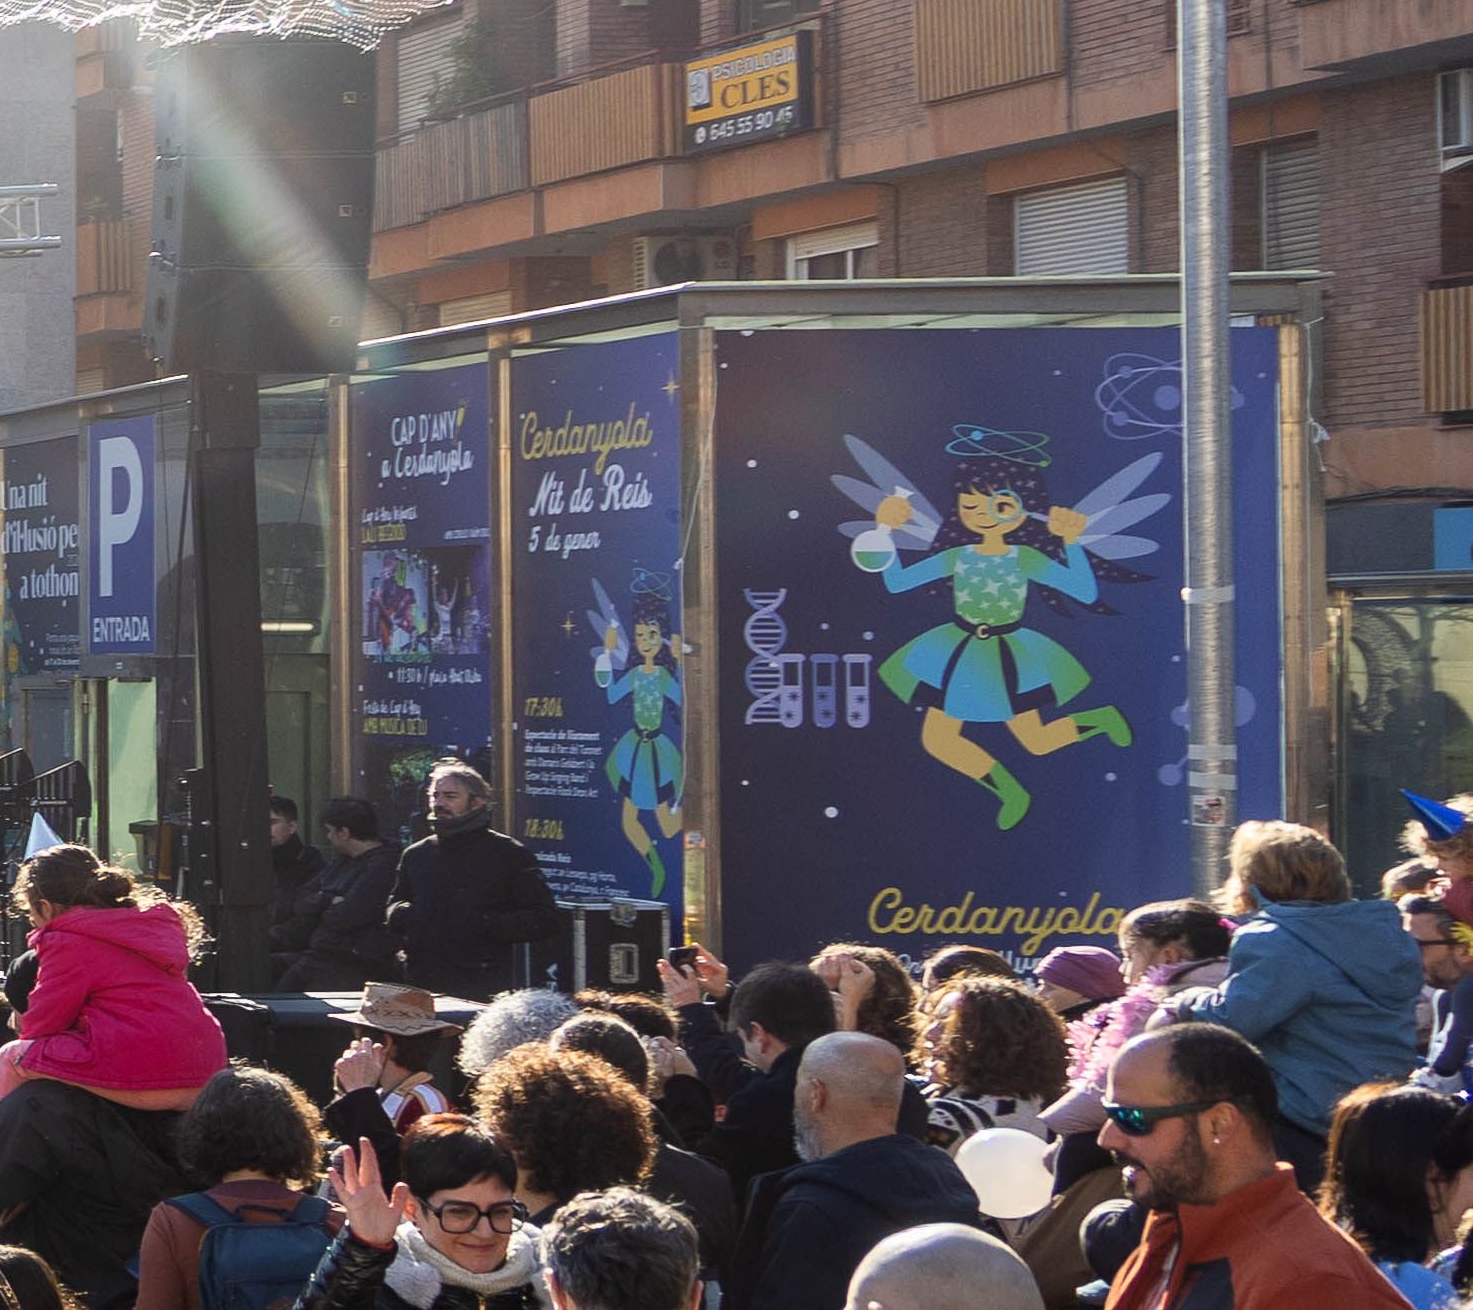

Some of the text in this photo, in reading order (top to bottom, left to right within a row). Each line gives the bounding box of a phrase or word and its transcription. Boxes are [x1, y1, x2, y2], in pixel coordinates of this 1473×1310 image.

[711, 45, 796, 81] PSICOLOGIA
[721, 69, 790, 109] CLES
[709, 122, 734, 140] 645
[736, 118, 753, 135] 55
[755, 111, 773, 131] 90
[392, 410, 457, 446] CAP D'ANY
[522, 402, 653, 475] Cerdanyola
[381, 441, 474, 485] a Cerdanyola
[28, 473, 48, 507] nit
[529, 464, 653, 516] Nit de Reis
[99, 436, 143, 597] P
[58, 523, 80, 558] pe
[528, 523, 601, 559] 5 de gener
[20, 575, 28, 599] a
[93, 615, 150, 642] ENTRADA
[525, 697, 563, 716] 17:30h
[868, 886, 1126, 956] Cerdanyola
